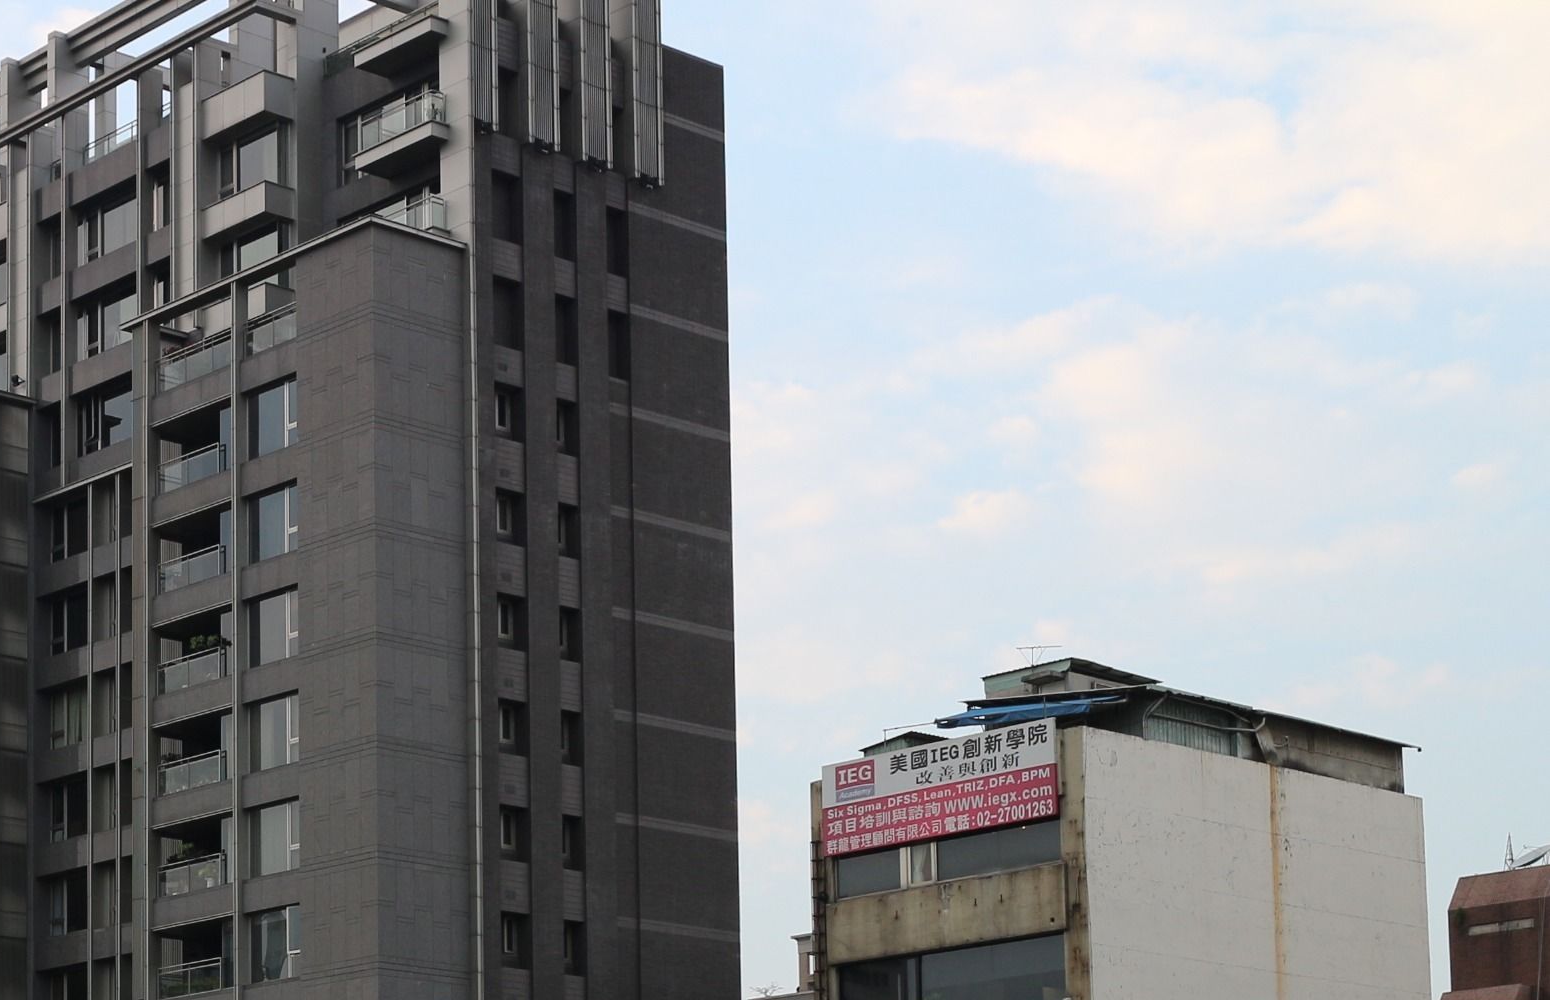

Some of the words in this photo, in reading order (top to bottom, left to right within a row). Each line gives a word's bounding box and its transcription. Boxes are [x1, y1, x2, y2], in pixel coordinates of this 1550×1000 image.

[890, 723, 1048, 775] 美國IEG創新學院
[838, 765, 871, 786] IEG
[916, 752, 1019, 785] 改善與創新
[828, 809, 844, 819] Six
[944, 785, 1052, 814] WWW.iegx.com
